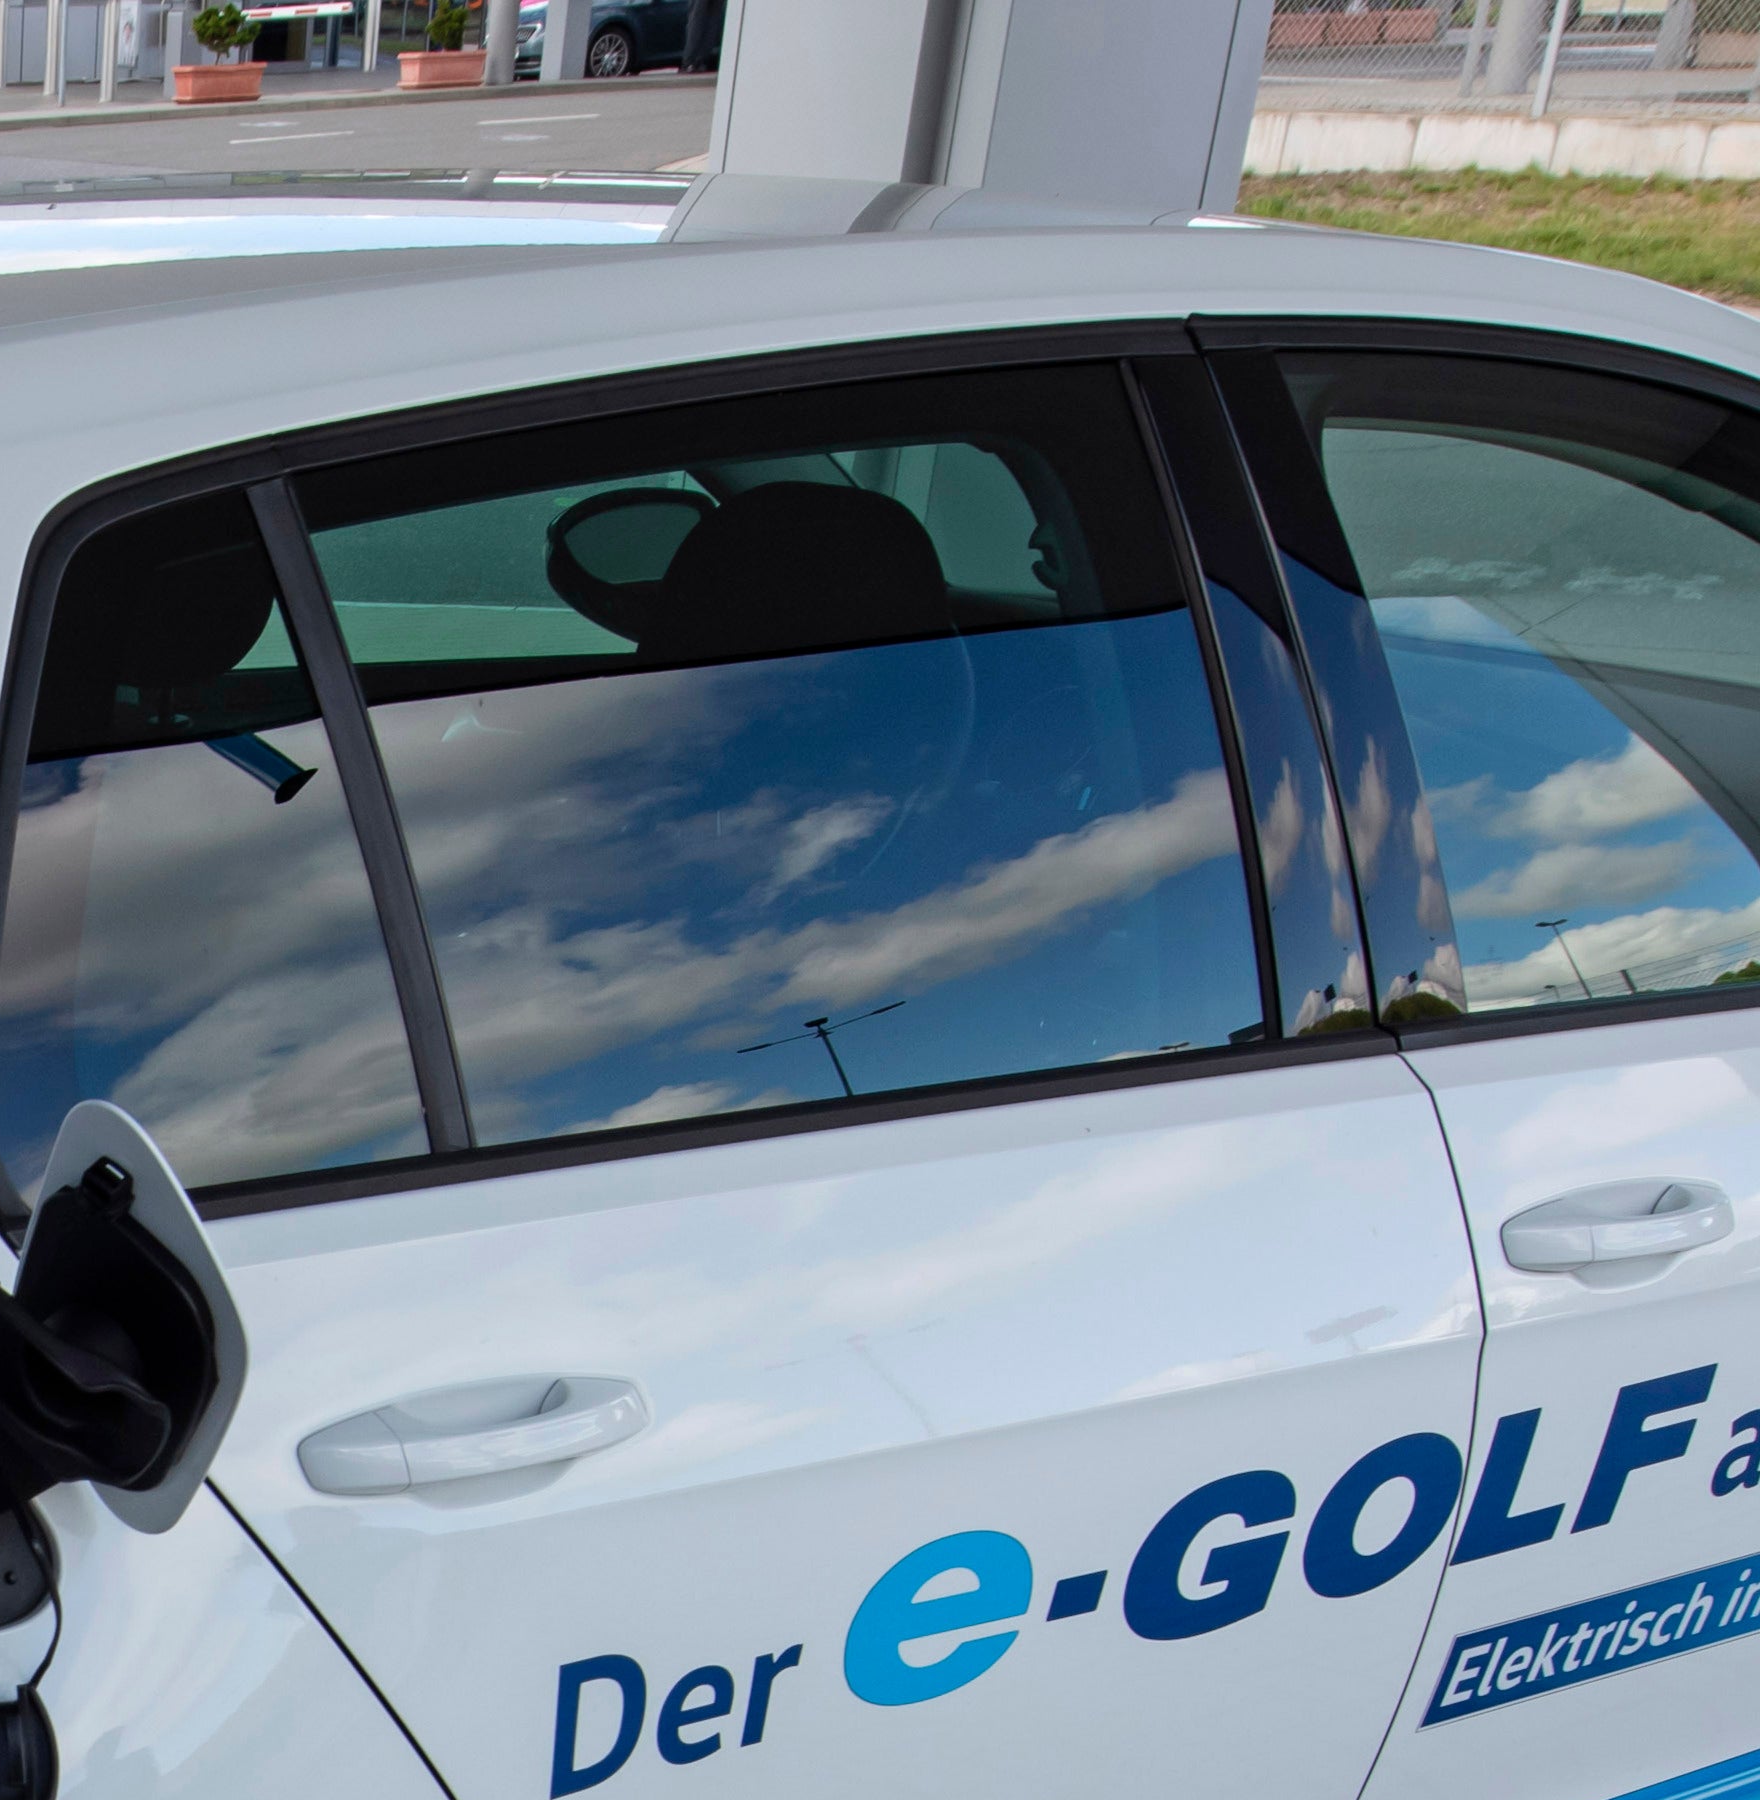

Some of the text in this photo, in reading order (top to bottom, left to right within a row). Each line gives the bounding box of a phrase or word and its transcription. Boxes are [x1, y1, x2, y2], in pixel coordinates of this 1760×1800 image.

[549, 1653, 803, 1800] Der
[843, 1363, 1718, 1706] e-GOLF
[1439, 1581, 1714, 1708] Elektrisch
